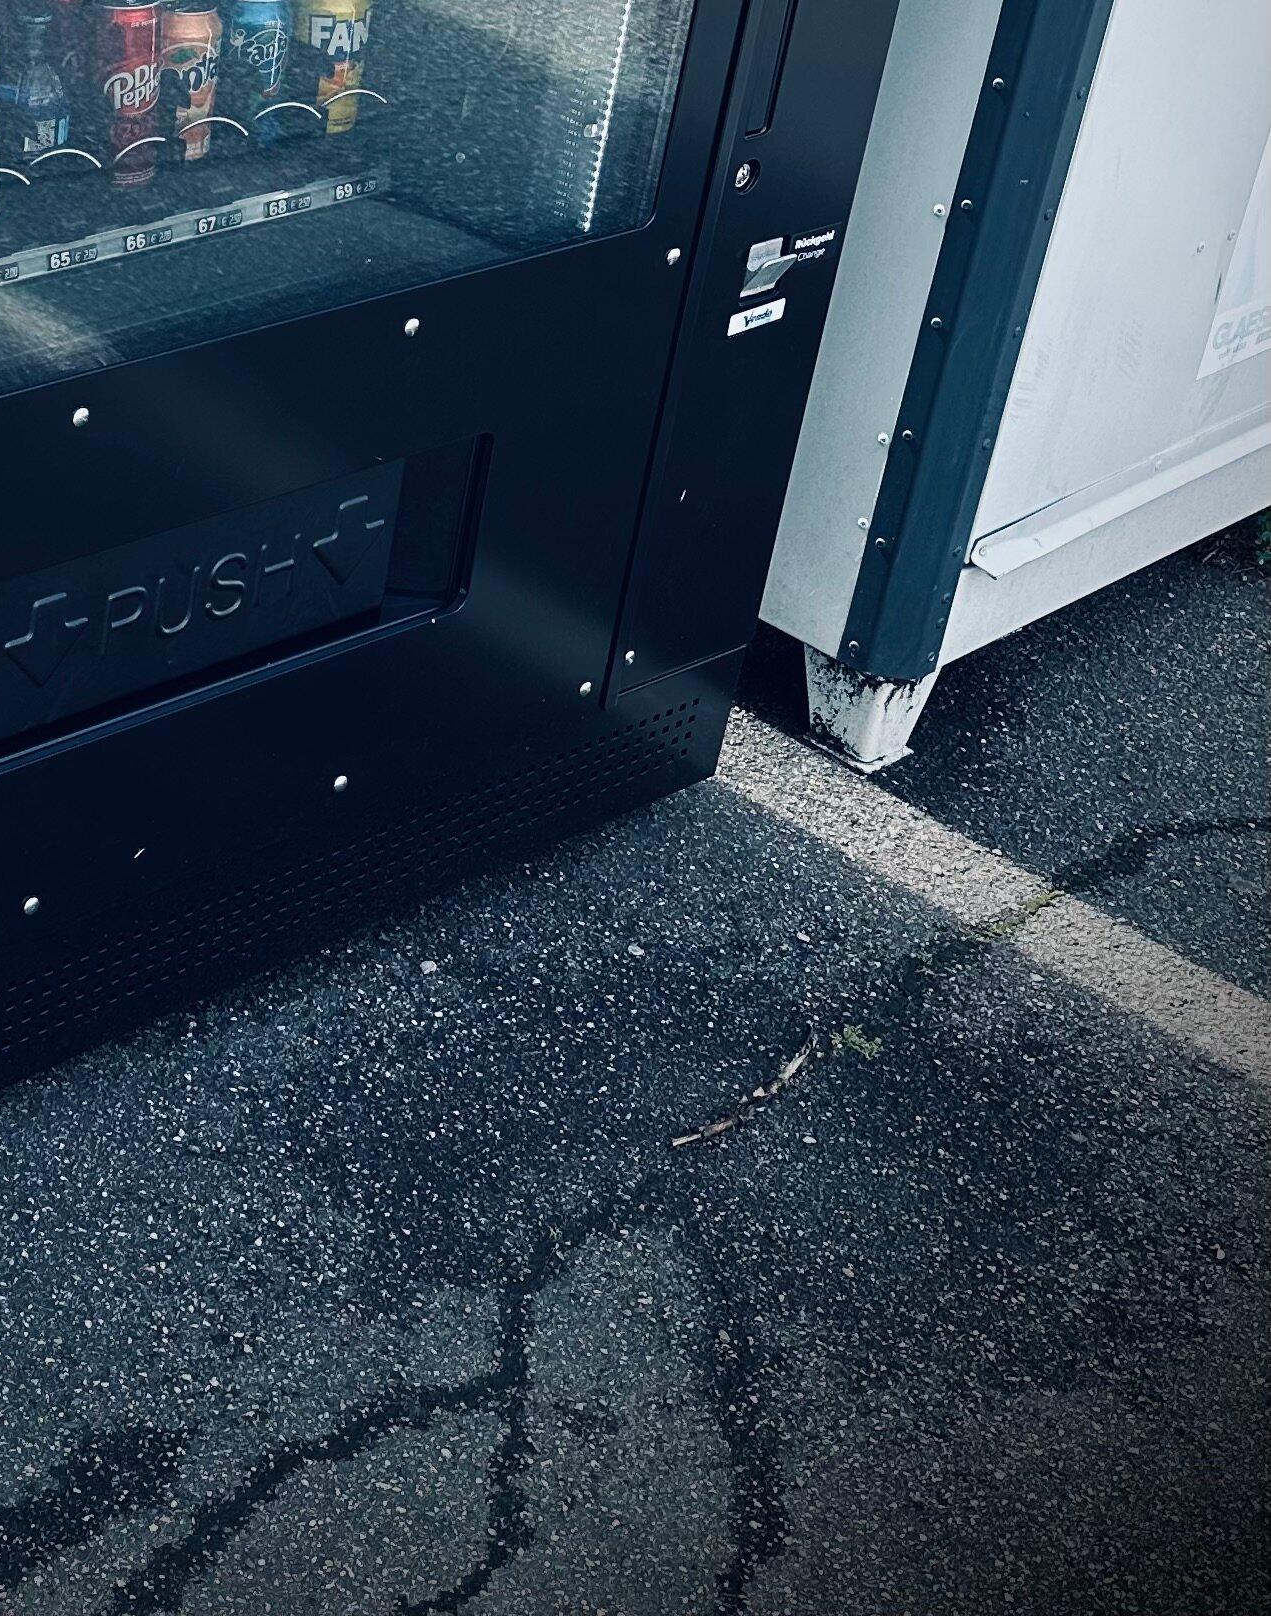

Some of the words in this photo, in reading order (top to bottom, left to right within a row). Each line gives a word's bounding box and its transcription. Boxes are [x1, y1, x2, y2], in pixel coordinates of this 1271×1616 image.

[336, 183, 353, 200] 69
[269, 199, 286, 216] 68
[198, 216, 216, 233] 67
[126, 234, 146, 251] 66
[51, 252, 70, 269] 65
[797, 248, 826, 262] Change
[100, 535, 302, 657] PUSH
